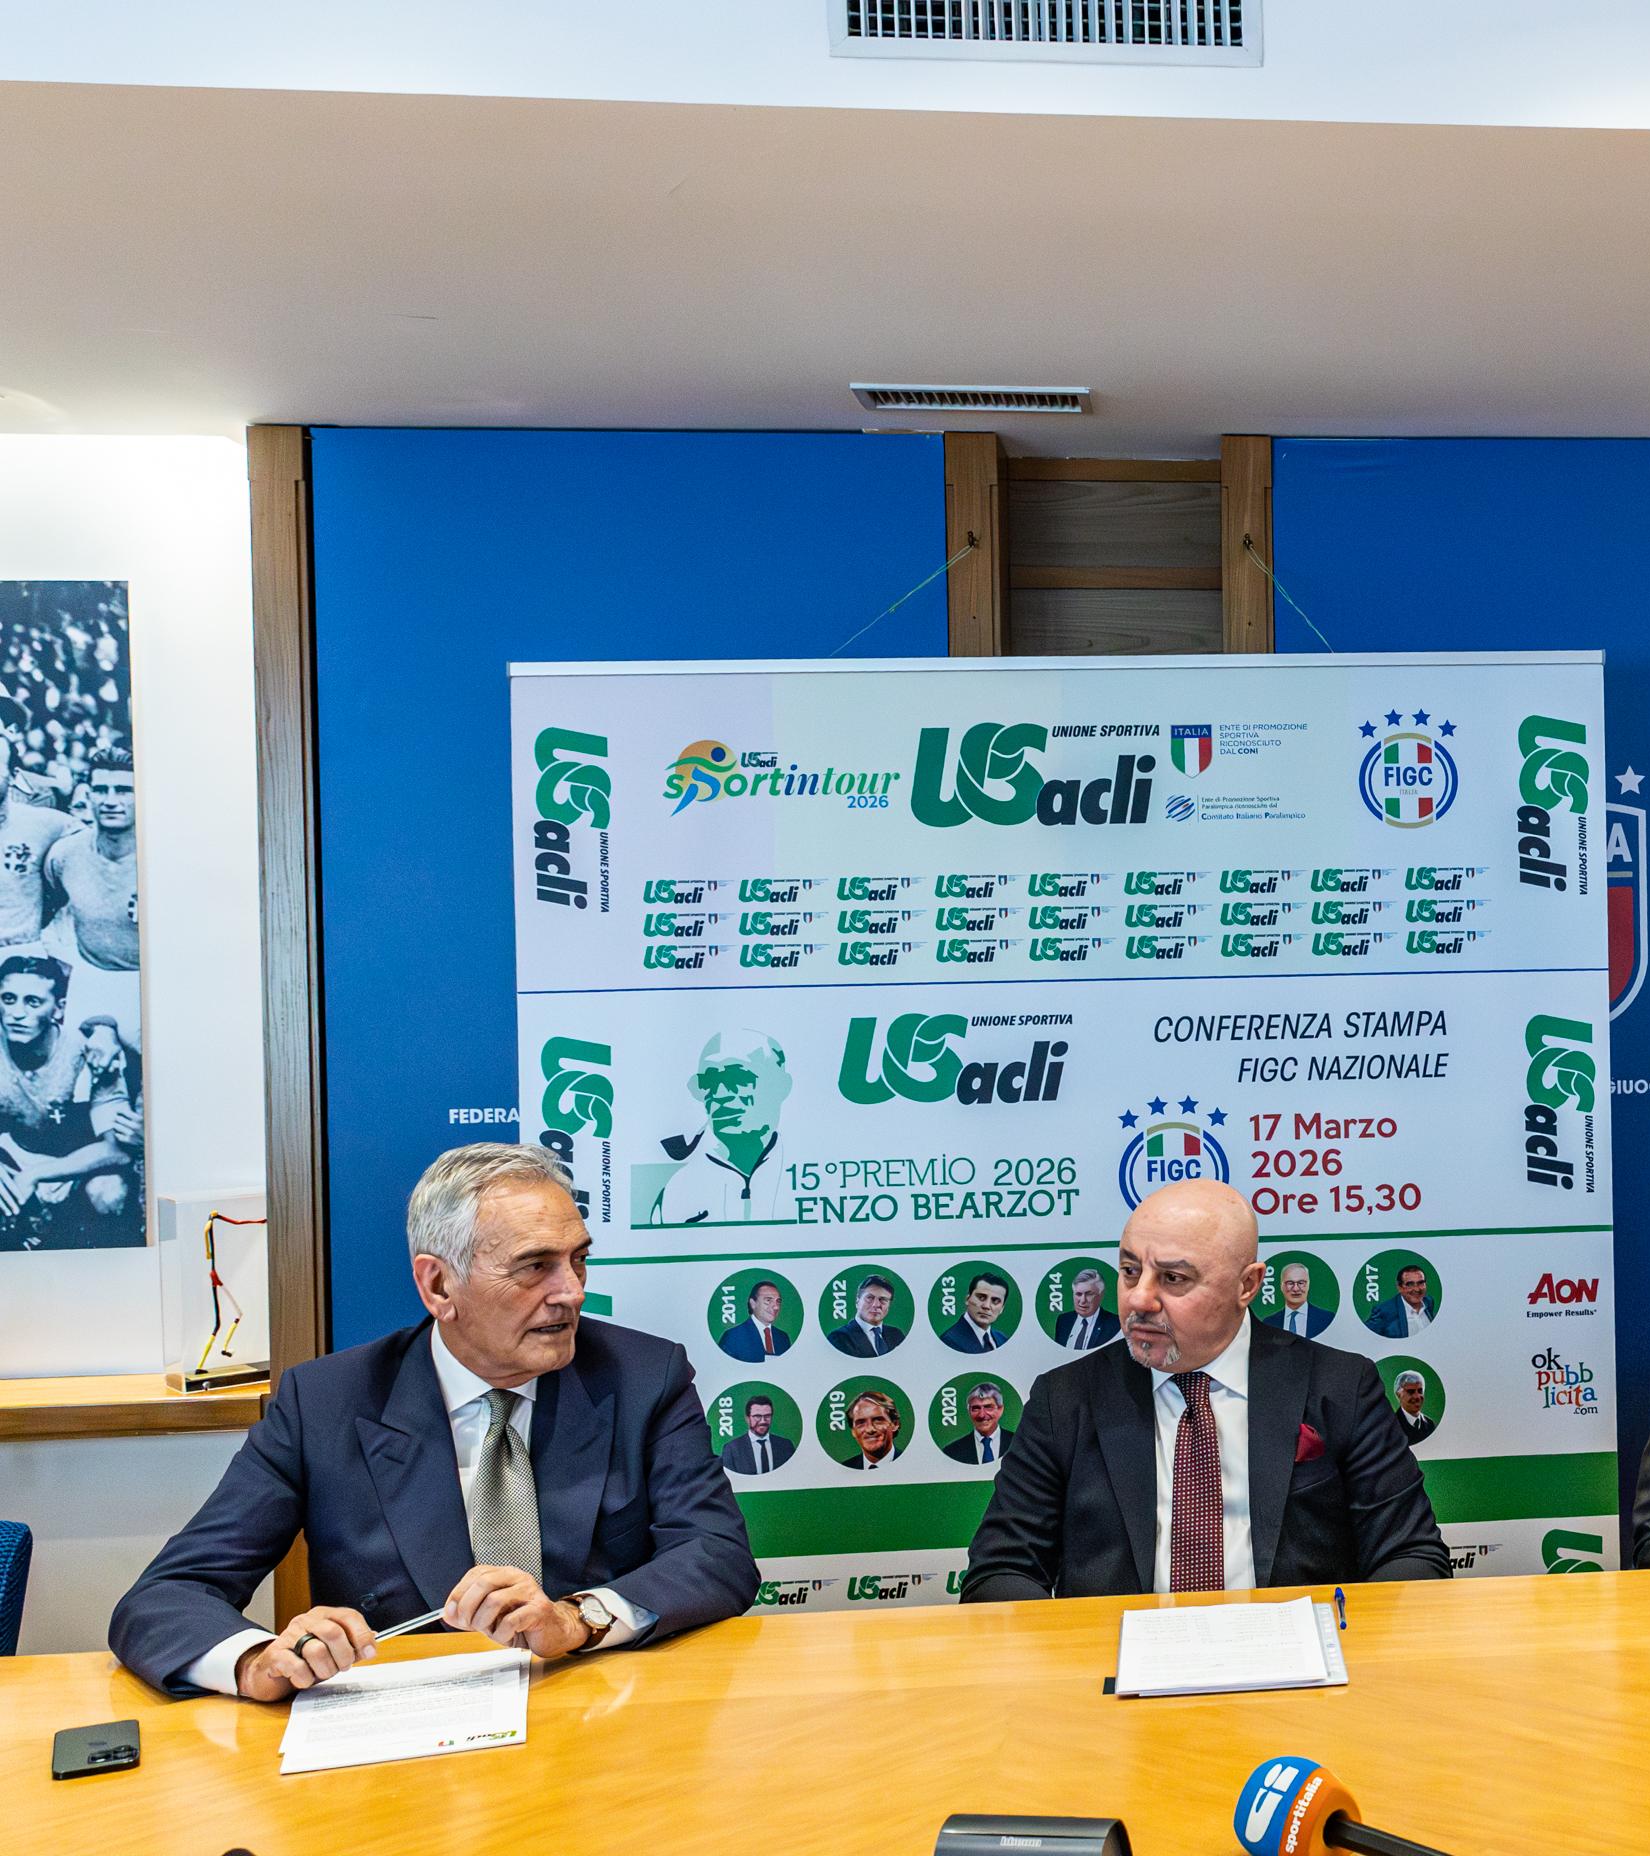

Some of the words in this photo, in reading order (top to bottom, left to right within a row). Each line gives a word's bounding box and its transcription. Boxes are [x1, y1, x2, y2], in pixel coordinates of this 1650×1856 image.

[1052, 725, 1097, 738] UNIONE
[1100, 724, 1160, 737] SPORTIVA
[1174, 727, 1209, 736] ITALIA
[1219, 732, 1260, 740] SPORTIVA
[1219, 739, 1282, 747] RICONOSCIUTO
[1252, 723, 1308, 731] PROMOZIONE
[1237, 747, 1259, 755] CONI
[1384, 766, 1433, 787] FIGC
[847, 795, 889, 809] 2026
[1256, 795, 1280, 803] Sportiva
[1201, 812, 1234, 820] Comitato
[1236, 812, 1262, 820] Italiano
[600, 831, 609, 867] UNIONE
[1578, 816, 1587, 852] UNIONE
[1579, 852, 1588, 895] SPORTIVA
[600, 868, 610, 913] SPORTIVA
[970, 1015, 1016, 1028] UNIONE
[1018, 1014, 1074, 1026] SPORTIVA
[1153, 1012, 1333, 1043] CONFERENZA
[1343, 1010, 1448, 1039] STAMPA
[1237, 1056, 1299, 1083] FIGC
[1307, 1052, 1450, 1081] NAZIONALE
[1249, 1113, 1282, 1142] 17
[1294, 1112, 1398, 1140] Marzo
[1584, 1114, 1594, 1150] UNIONE
[601, 1140, 611, 1178] UNIONE
[993, 1157, 1077, 1187] 2026
[1146, 1158, 1202, 1182] FIGC
[1251, 1148, 1343, 1179] 2026
[1585, 1150, 1595, 1193] SPORTIVA
[601, 1178, 611, 1223] SPORTIVA
[795, 1194, 899, 1224] ENZO
[910, 1188, 1080, 1221] BEARZOT
[1251, 1187, 1319, 1215] Ore
[1329, 1182, 1422, 1216] 15,30
[941, 1275, 956, 1316] 2013
[1049, 1272, 1063, 1313] 2014
[1262, 1265, 1275, 1305] 2016
[1365, 1263, 1379, 1302] 2017
[721, 1284, 736, 1325] 2011
[832, 1279, 847, 1320] 2012
[1526, 1309, 1563, 1320] Empower
[1531, 1347, 1564, 1371] ok
[1535, 1362, 1594, 1391] pubb
[829, 1390, 846, 1432] 2019
[941, 1386, 958, 1427] 2020
[1542, 1385, 1598, 1409] licita
[719, 1396, 734, 1438] 2018
[1285, 1776, 1324, 1855] sportitalia
